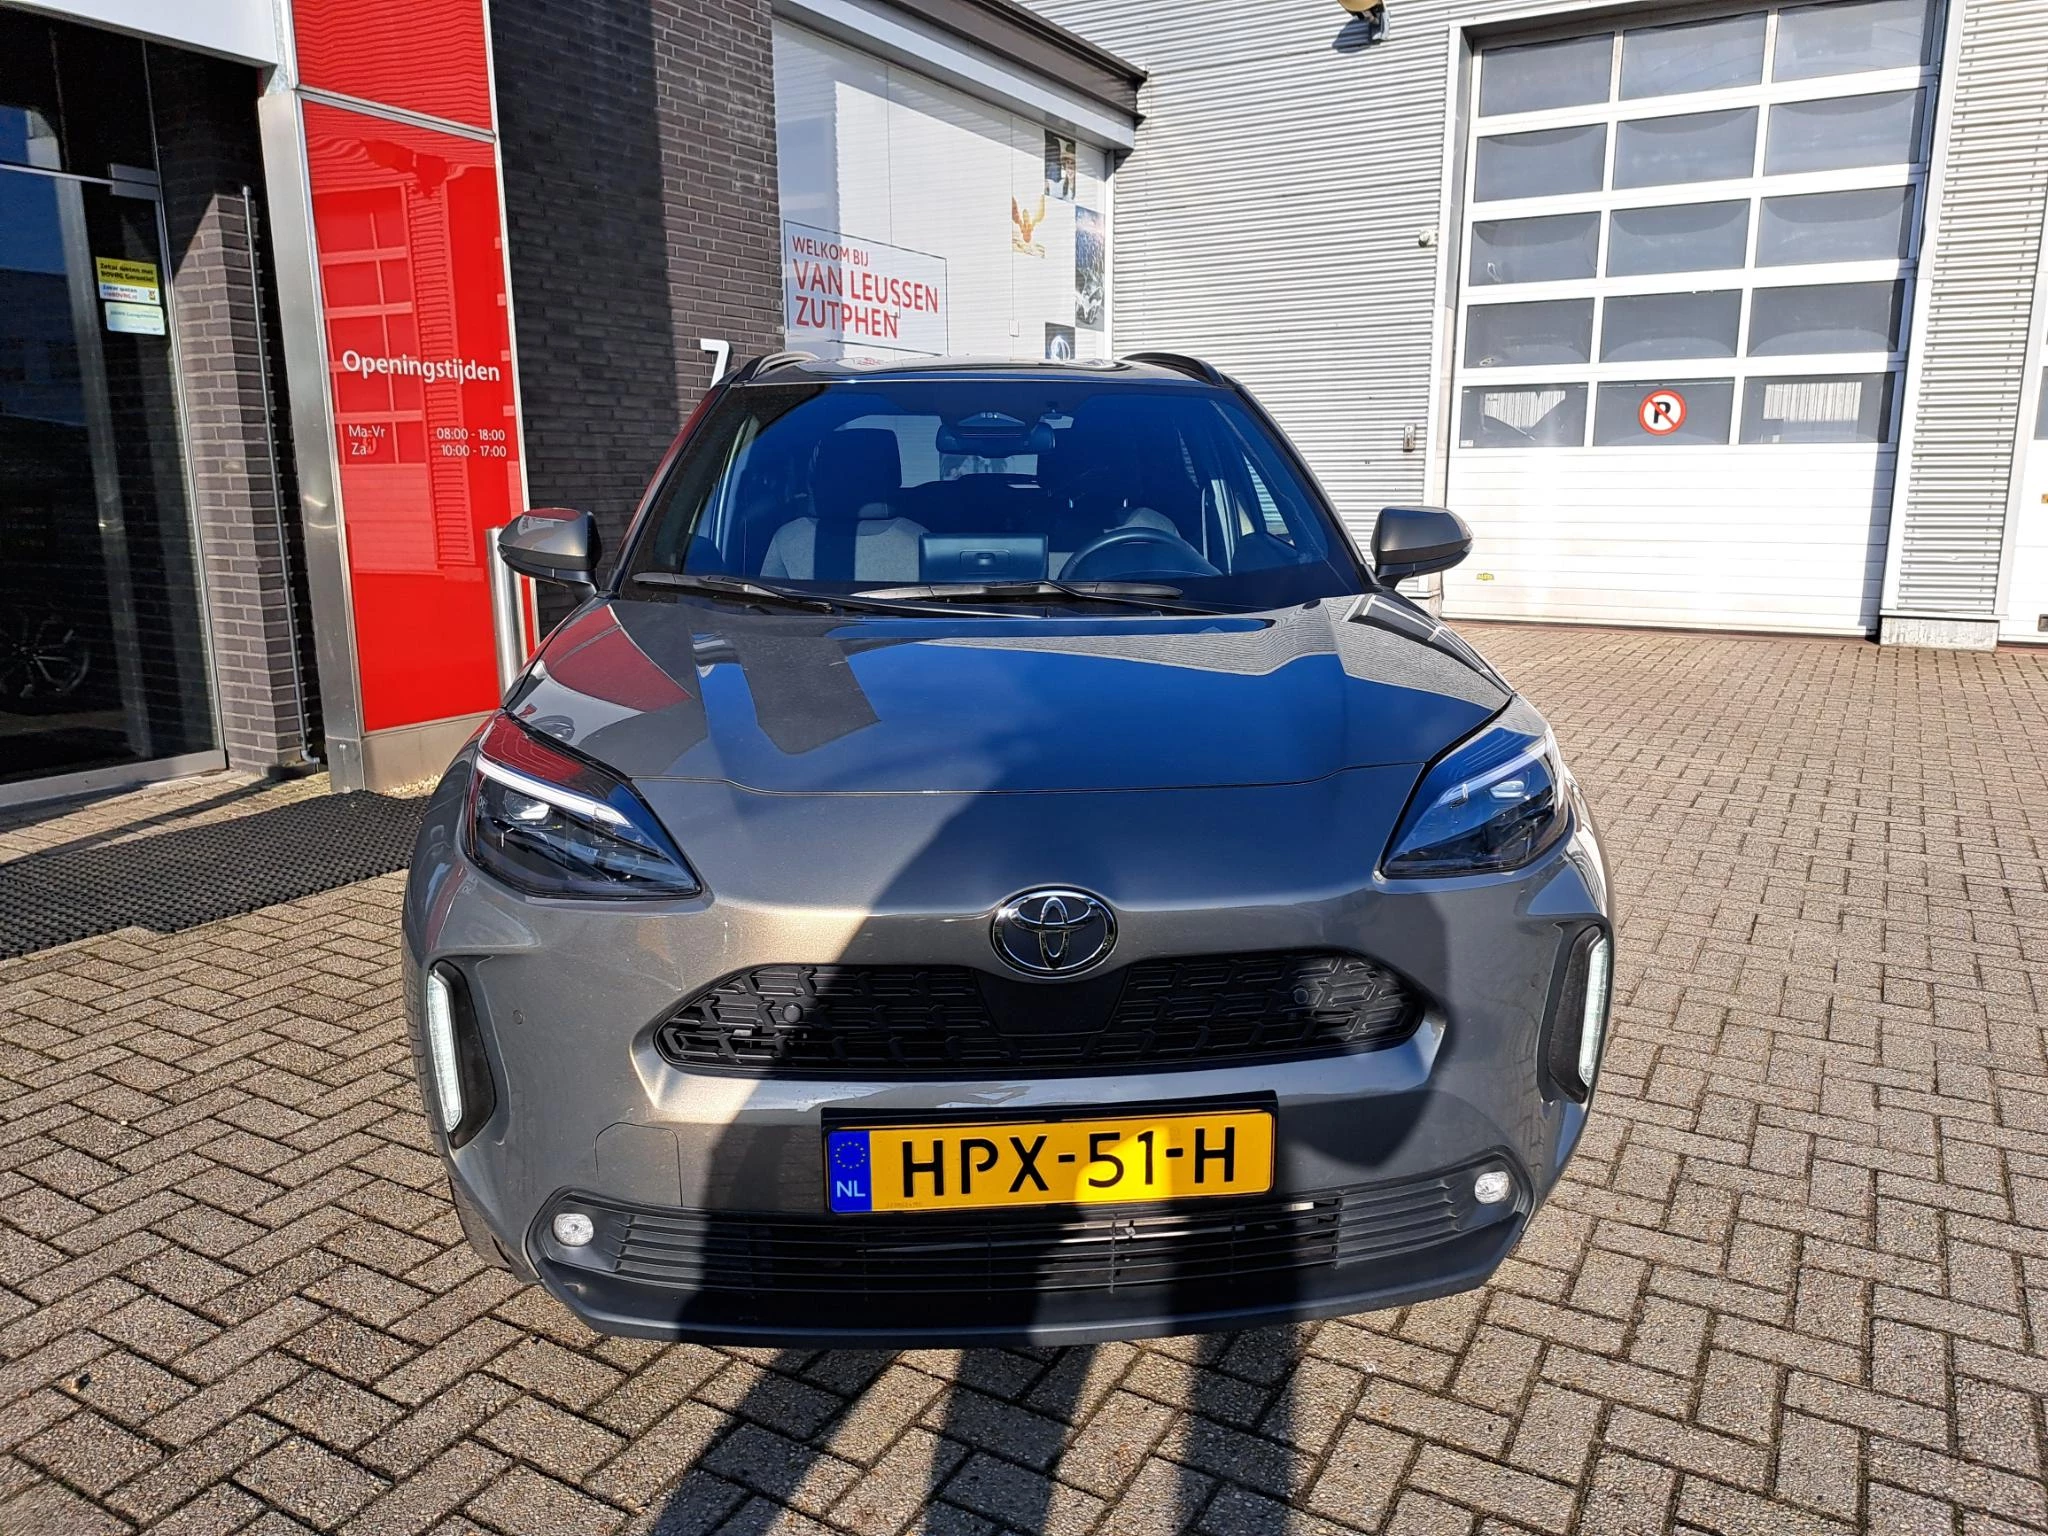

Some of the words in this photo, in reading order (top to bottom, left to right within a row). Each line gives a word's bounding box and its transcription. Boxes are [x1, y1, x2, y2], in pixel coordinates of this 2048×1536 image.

[792, 235, 850, 264] WELKOM
[853, 249, 869, 267] BIJ
[792, 258, 844, 297] VAN
[850, 270, 938, 313] LEUSSEN
[795, 295, 899, 339] ZUTPHEN
[342, 350, 500, 384] Openingstijden
[700, 338, 729, 388] 7
[1653, 401, 1671, 424] P
[348, 424, 387, 439] Ma-Vr
[436, 428, 469, 441] 08:00
[479, 429, 506, 442] 18:00
[352, 442, 367, 456] Za
[441, 444, 470, 457] 10:00
[480, 445, 507, 458] 17:00
[901, 1126, 1236, 1199] HPX-51-H
[836, 1180, 866, 1199] NL
